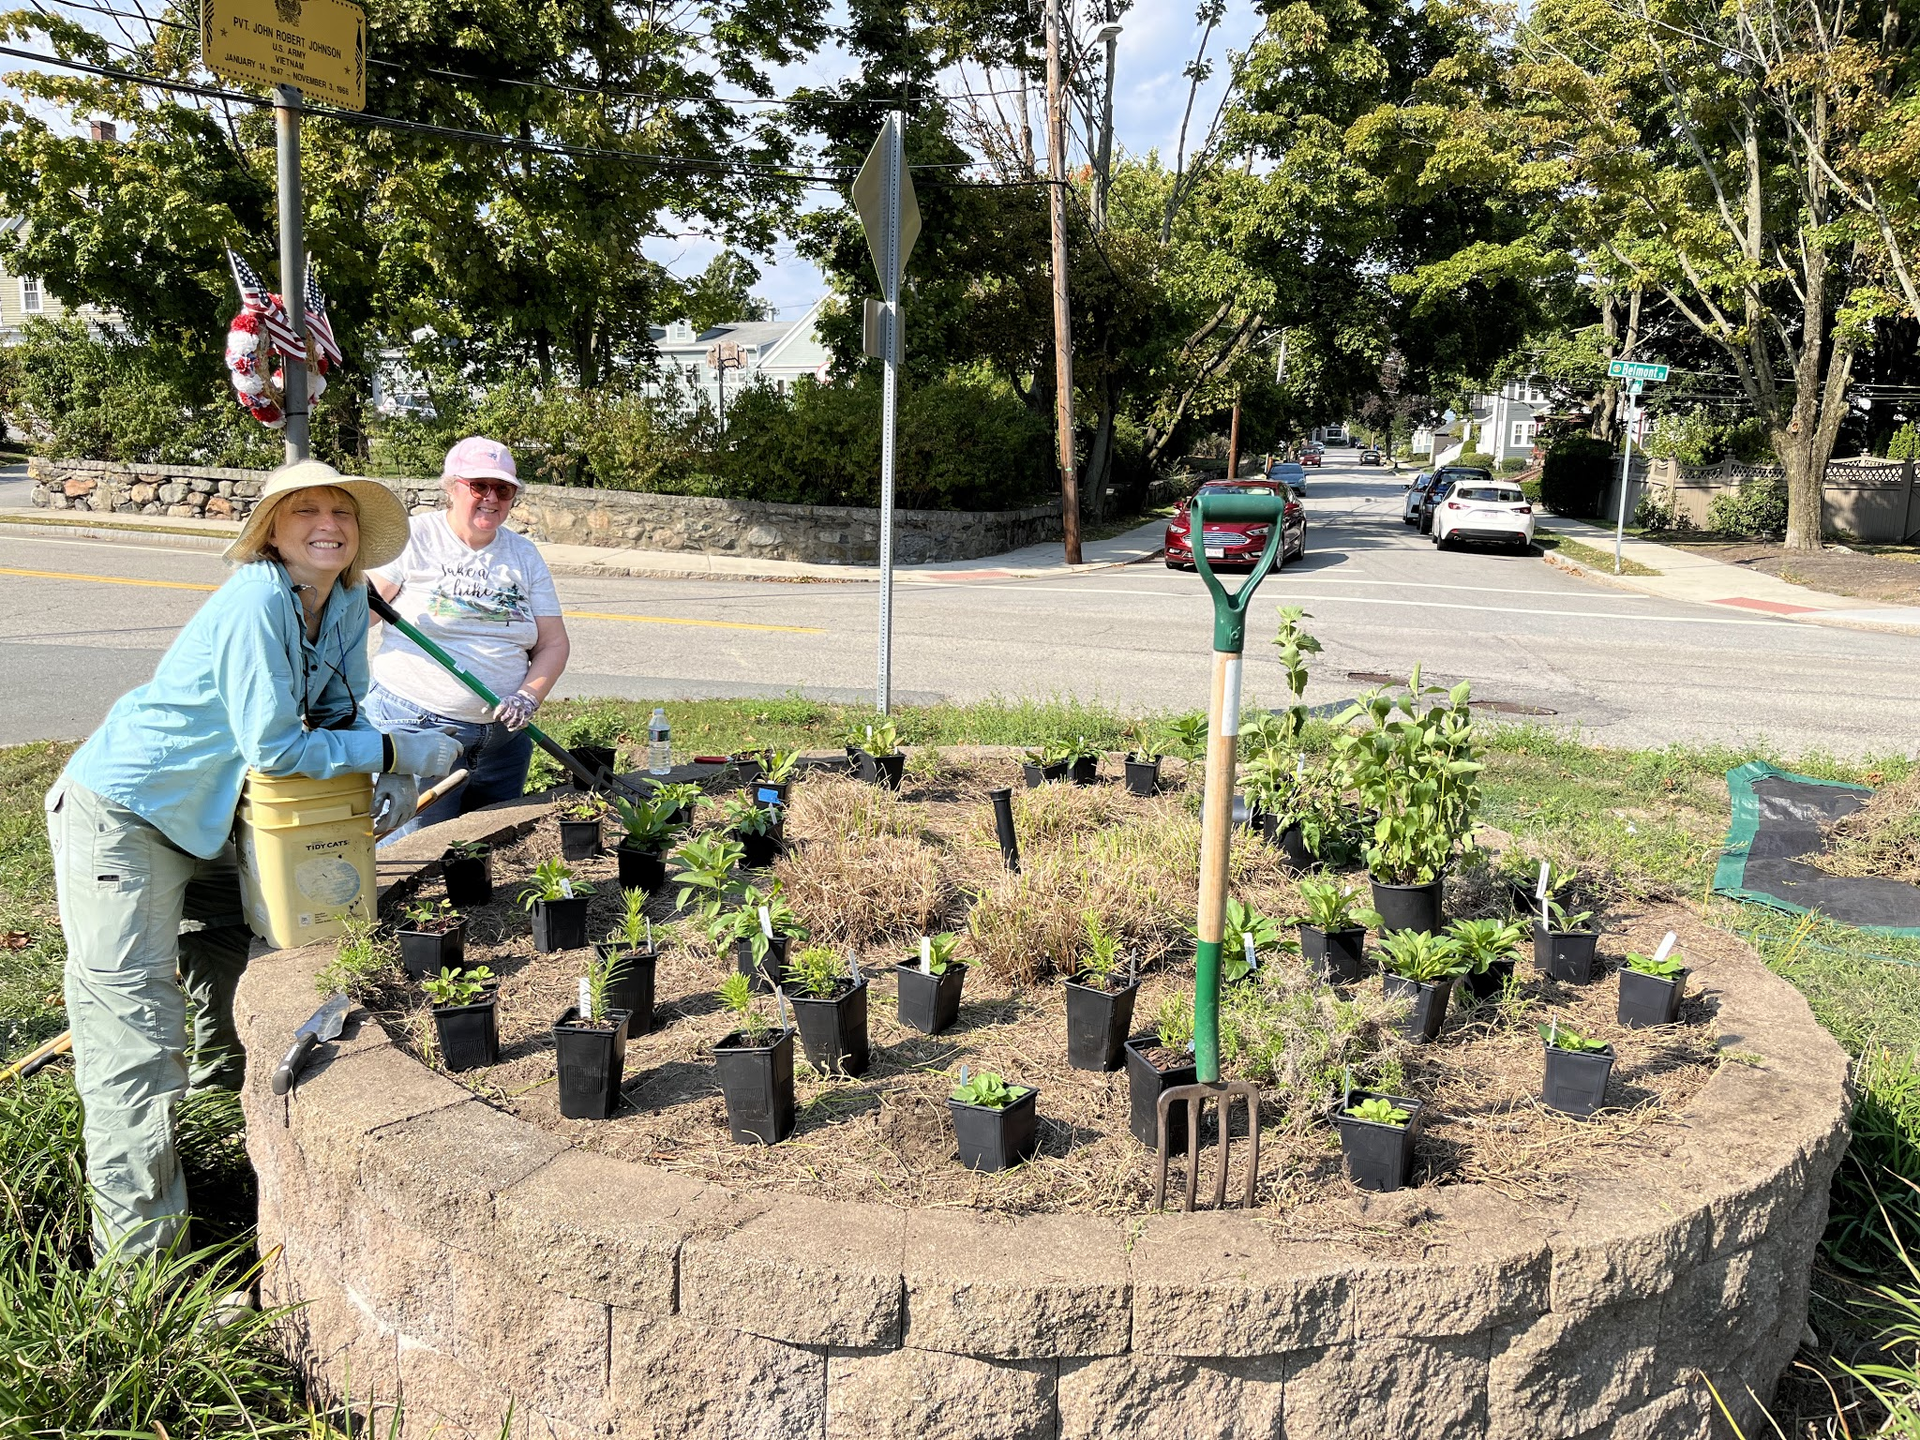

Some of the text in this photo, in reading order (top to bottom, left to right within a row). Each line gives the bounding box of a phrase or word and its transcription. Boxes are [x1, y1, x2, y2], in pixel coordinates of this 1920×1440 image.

[233, 16, 342, 60] PVT. JOHN ROBERT JOHNSON
[272, 42, 306, 60] U.S. ARMY
[224, 53, 256, 68] JANUARY
[270, 65, 284, 76] 1947
[292, 71, 326, 89] NOVEMBER
[275, 55, 305, 71] VIETNAM
[1622, 364, 1658, 378] Belmont
[478, 567, 490, 580] a
[453, 578, 494, 598] hike
[305, 839, 348, 851] TIDY CATS
